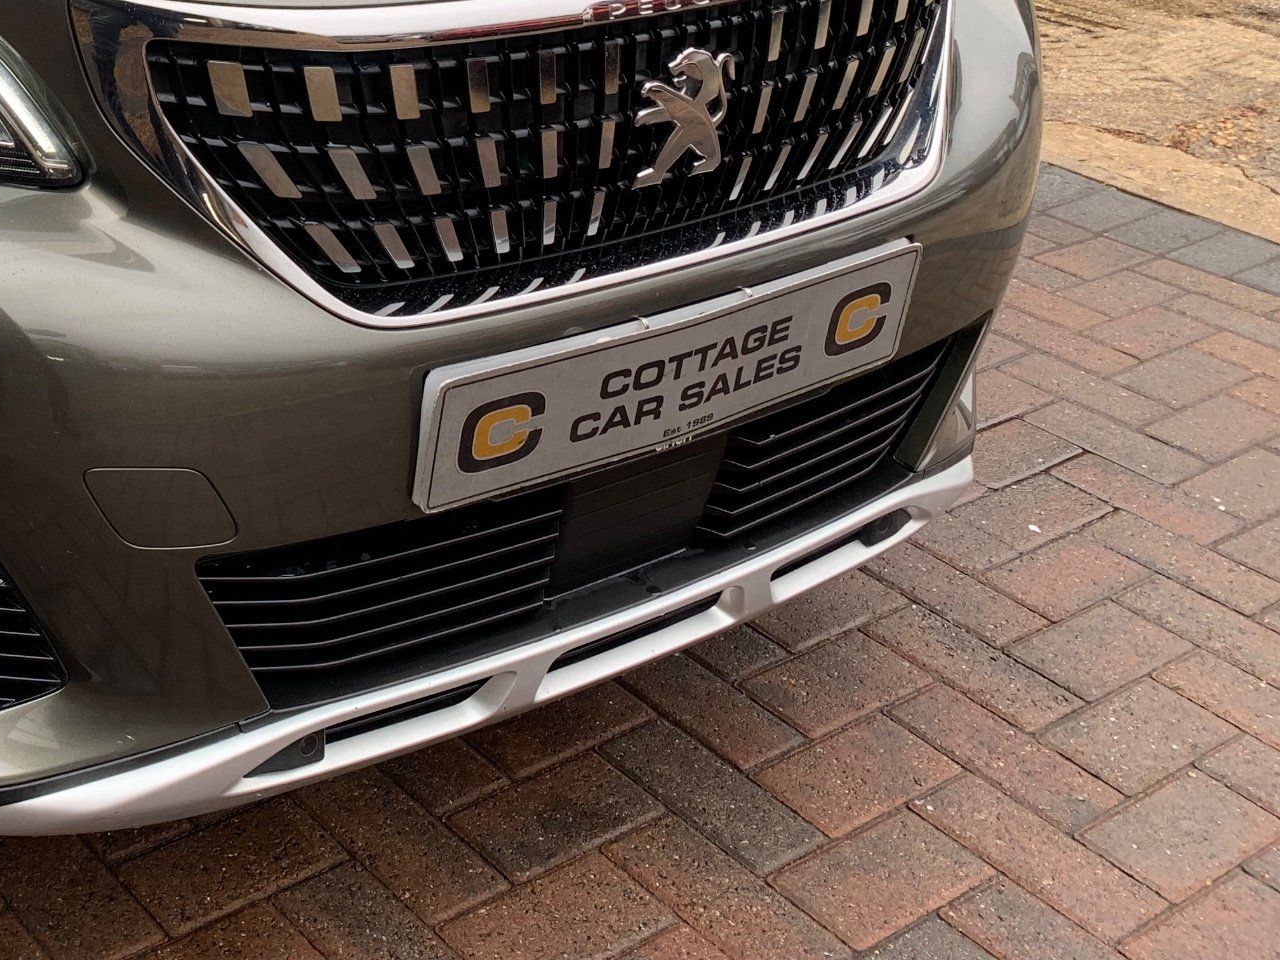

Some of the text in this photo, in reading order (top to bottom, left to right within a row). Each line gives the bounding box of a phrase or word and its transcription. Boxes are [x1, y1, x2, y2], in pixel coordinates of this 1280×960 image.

[570, 345, 802, 442] CAR SALES
[600, 315, 793, 400] COTTAGE
[662, 412, 714, 438] Est 1989
